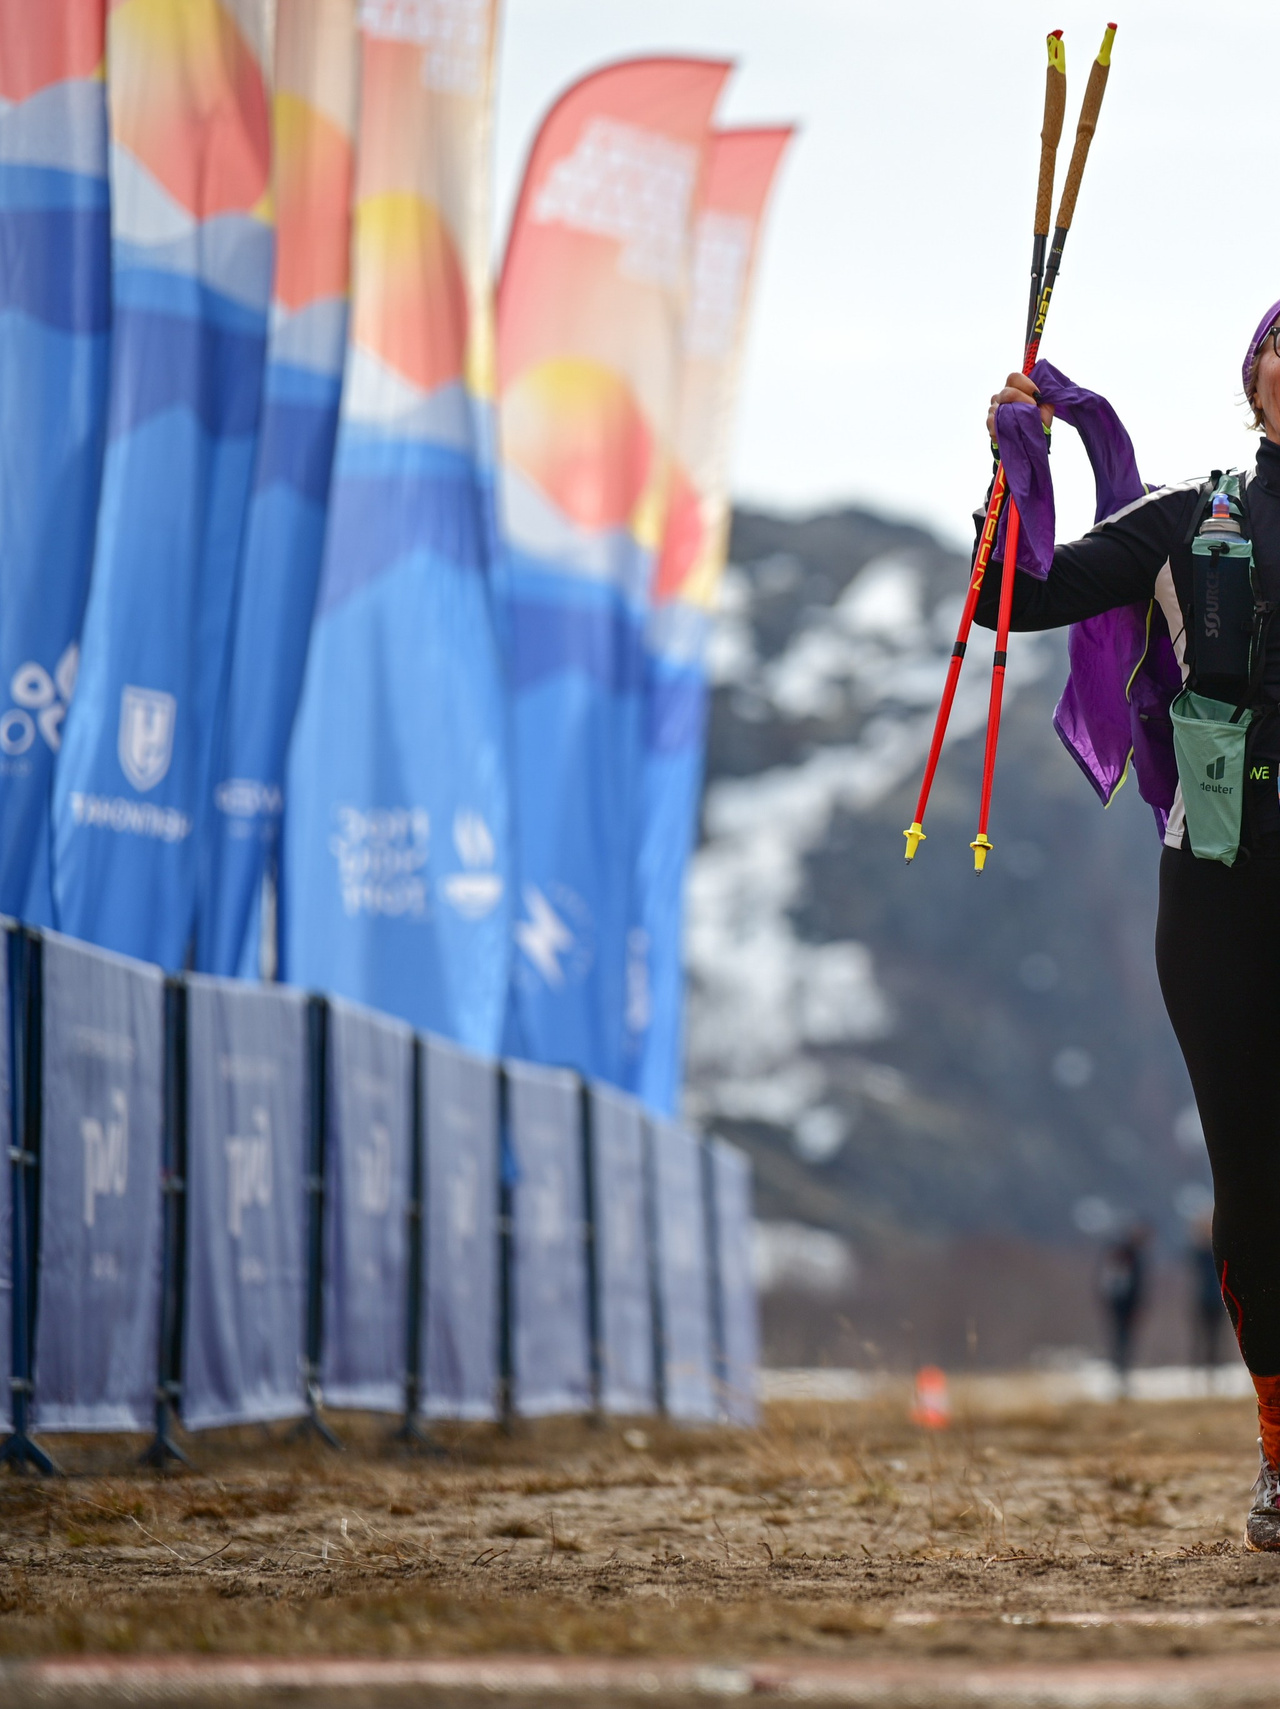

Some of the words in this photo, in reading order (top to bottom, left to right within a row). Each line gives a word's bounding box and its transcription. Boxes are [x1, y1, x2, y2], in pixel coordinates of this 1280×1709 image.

[1034, 286, 1053, 334] LEKI
[1203, 570, 1221, 638] SOURCE
[1200, 782, 1234, 795] deuter
